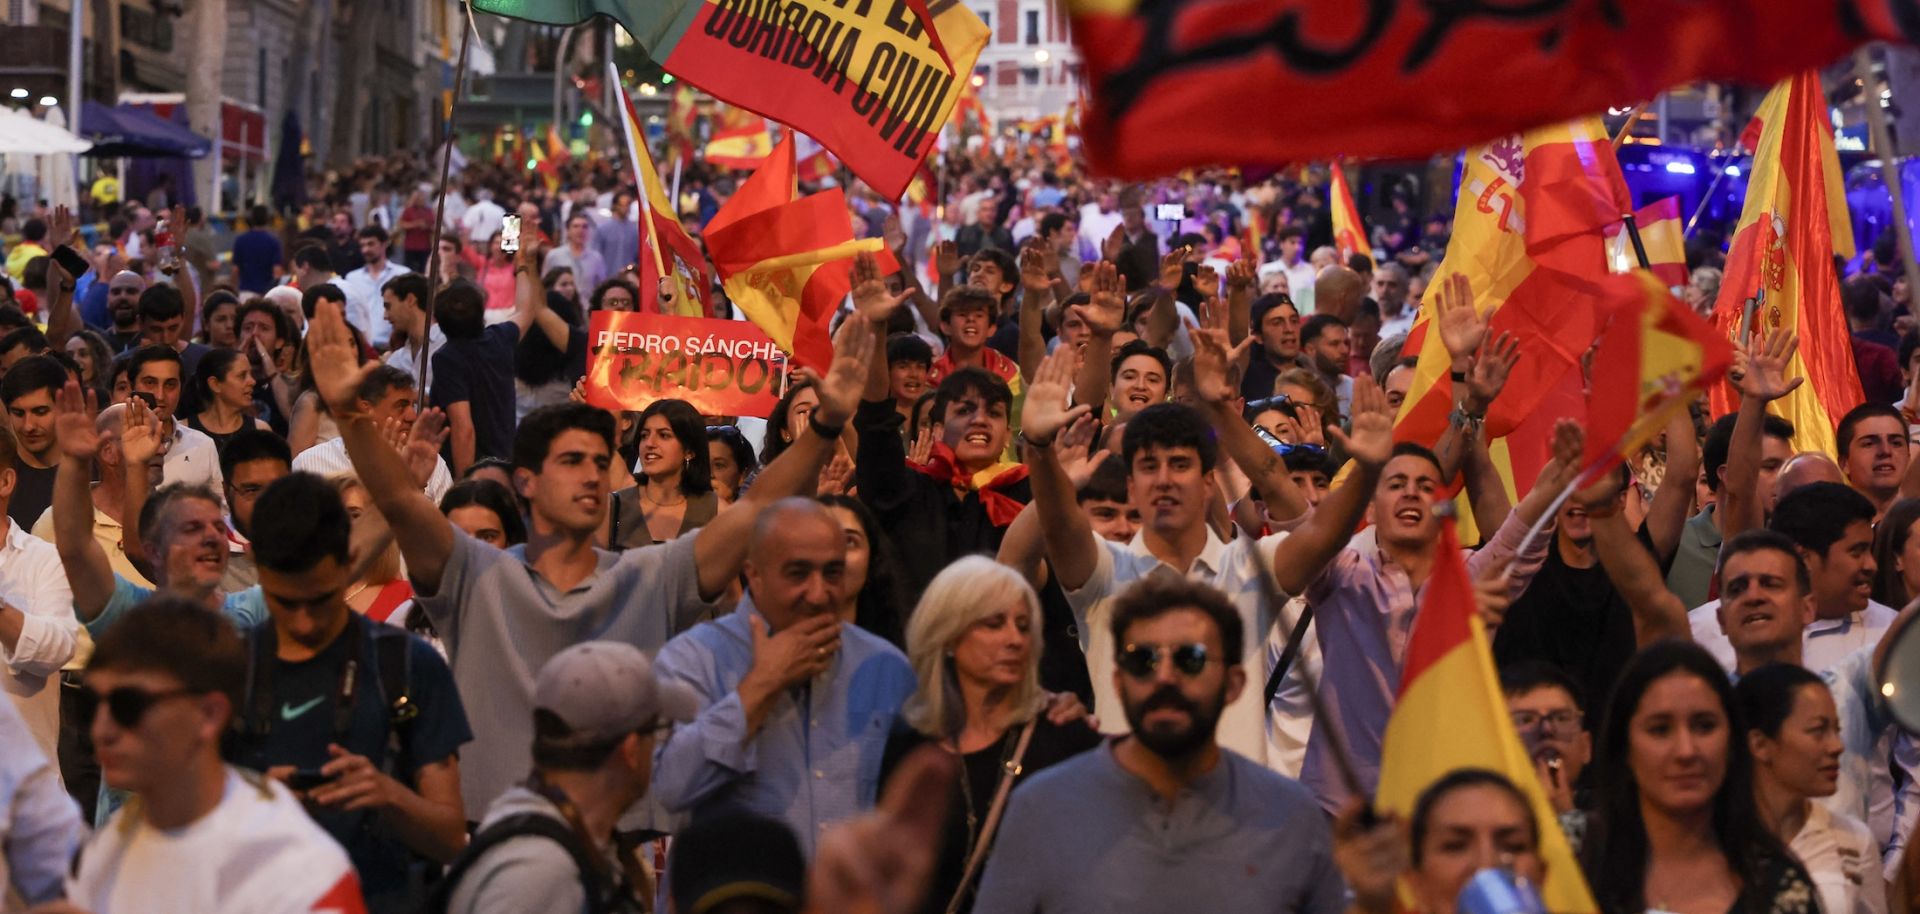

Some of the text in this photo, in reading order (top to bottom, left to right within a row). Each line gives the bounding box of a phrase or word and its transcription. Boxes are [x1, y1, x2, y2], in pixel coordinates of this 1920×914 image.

[704, 0, 861, 95] GUARDIA
[852, 42, 954, 160] CIVIL
[598, 330, 785, 361] PEDRO SÁNCHE
[592, 346, 783, 398] TRAIDO
